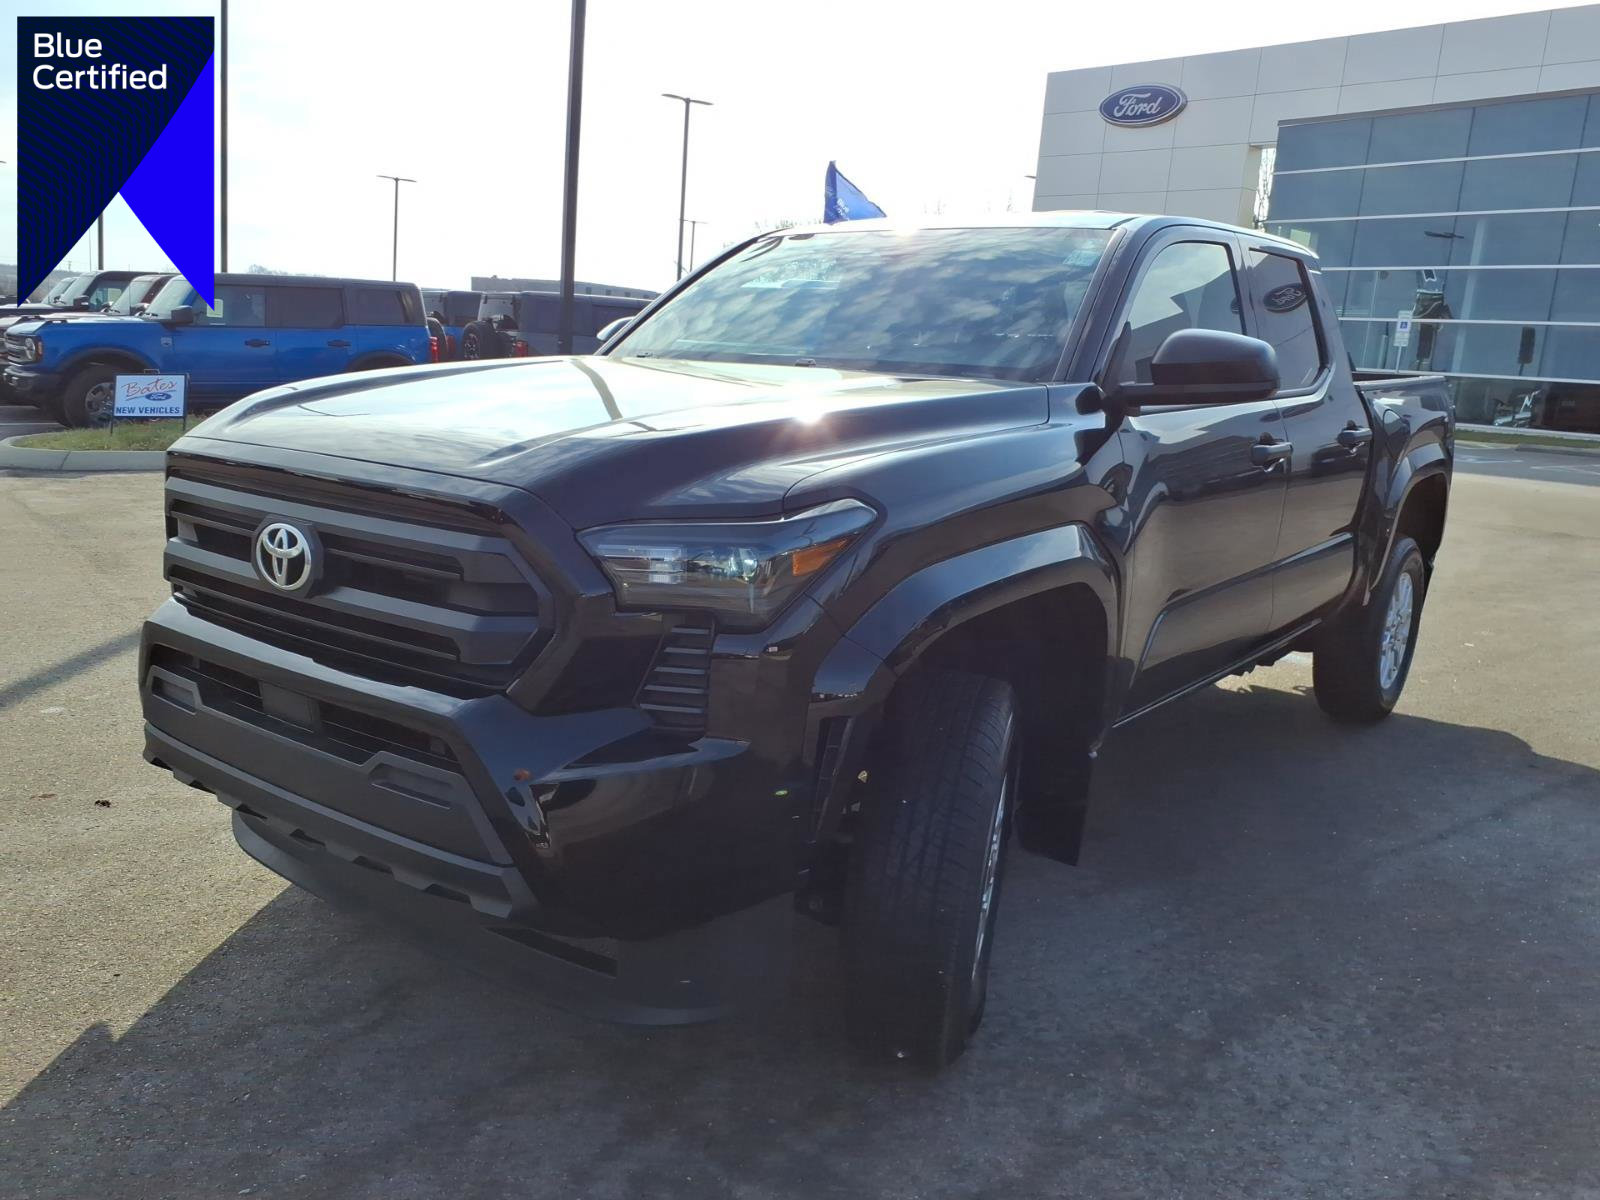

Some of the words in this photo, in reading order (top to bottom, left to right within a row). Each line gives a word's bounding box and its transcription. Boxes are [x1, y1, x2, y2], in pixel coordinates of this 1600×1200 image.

[1113, 92, 1163, 117] Ford
[120, 378, 178, 398] Bates
[115, 406, 136, 414] NEW
[138, 406, 181, 414] VEHICLES
